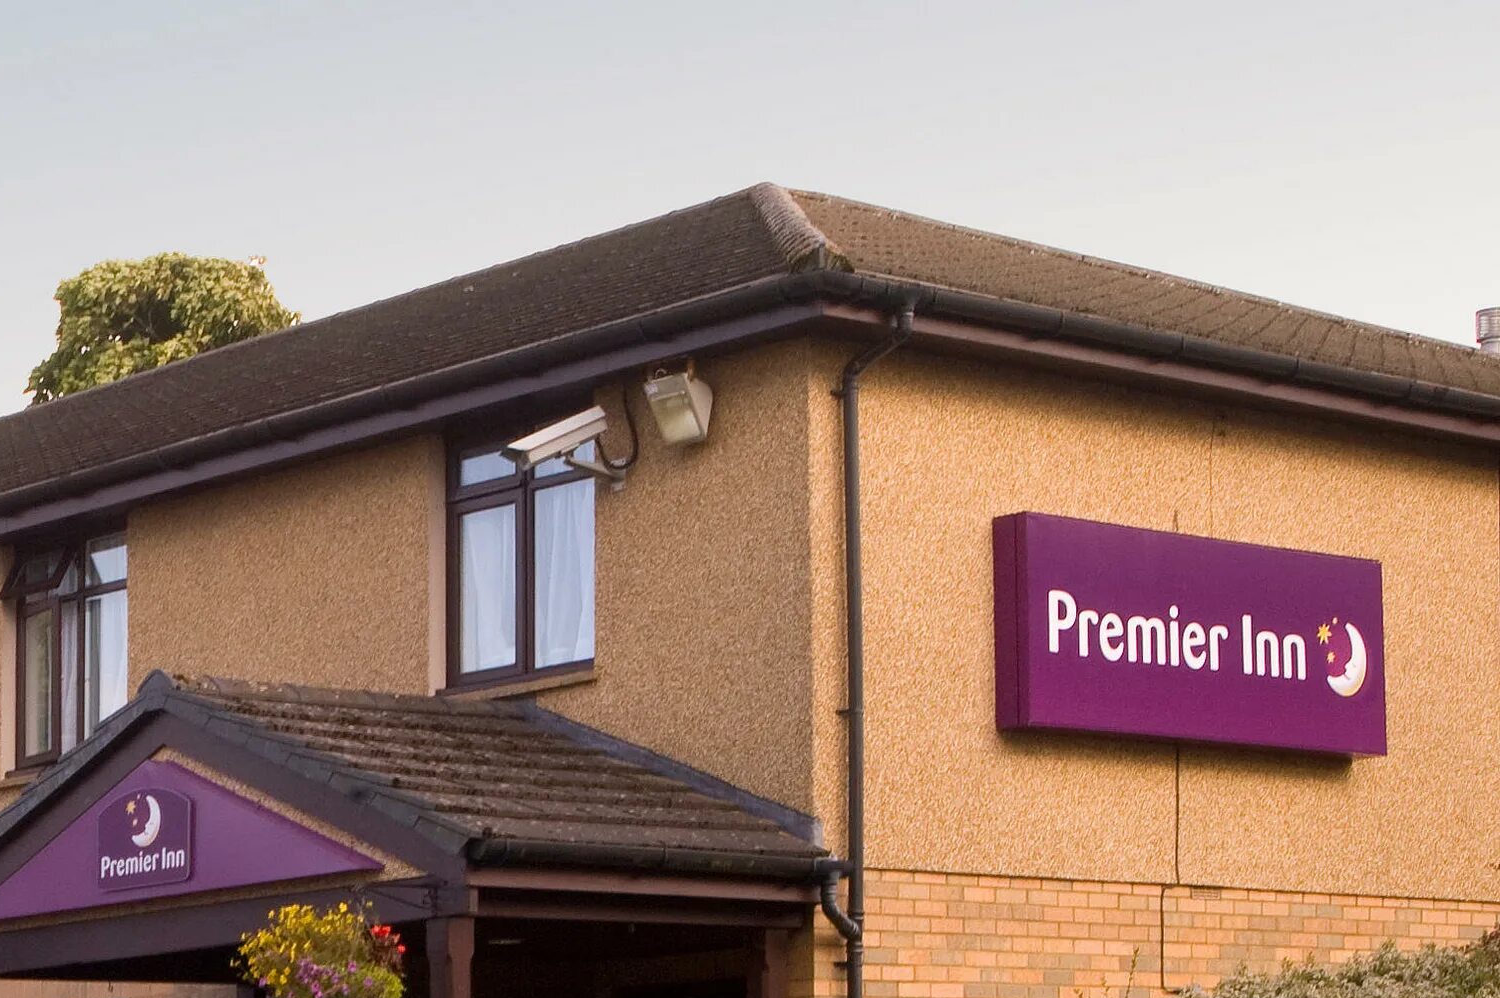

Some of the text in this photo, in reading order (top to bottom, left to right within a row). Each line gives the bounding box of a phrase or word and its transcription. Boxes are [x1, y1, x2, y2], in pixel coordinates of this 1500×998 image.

[1047, 589, 1307, 681] Premier Inn
[100, 846, 185, 879] Premier Inn
